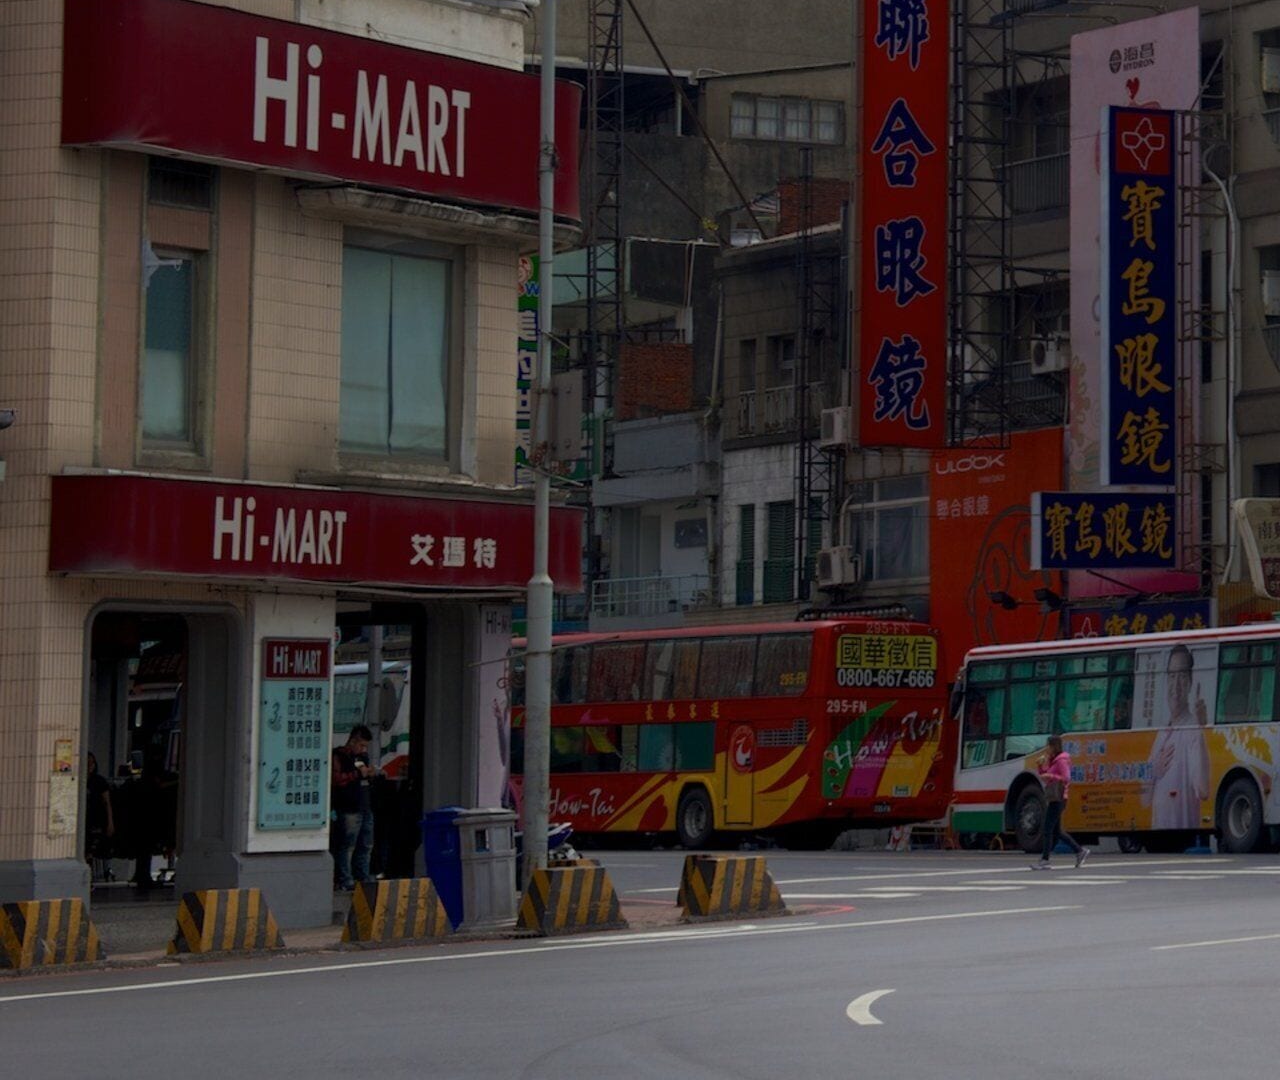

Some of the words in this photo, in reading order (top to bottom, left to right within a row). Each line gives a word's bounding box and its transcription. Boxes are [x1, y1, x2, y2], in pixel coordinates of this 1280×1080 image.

[252, 36, 471, 178] Hi-MART
[1115, 179, 1172, 474] 寶島眼鏡
[213, 496, 347, 566] Hi-MART
[1044, 503, 1173, 561] 寶島眼鏡
[410, 532, 498, 570] 艾瑪特
[272, 645, 322, 675] Hi-MART
[840, 636, 934, 668] 國華徵信
[836, 668, 935, 688] 0800-667-666
[826, 699, 868, 713] 295-FN
